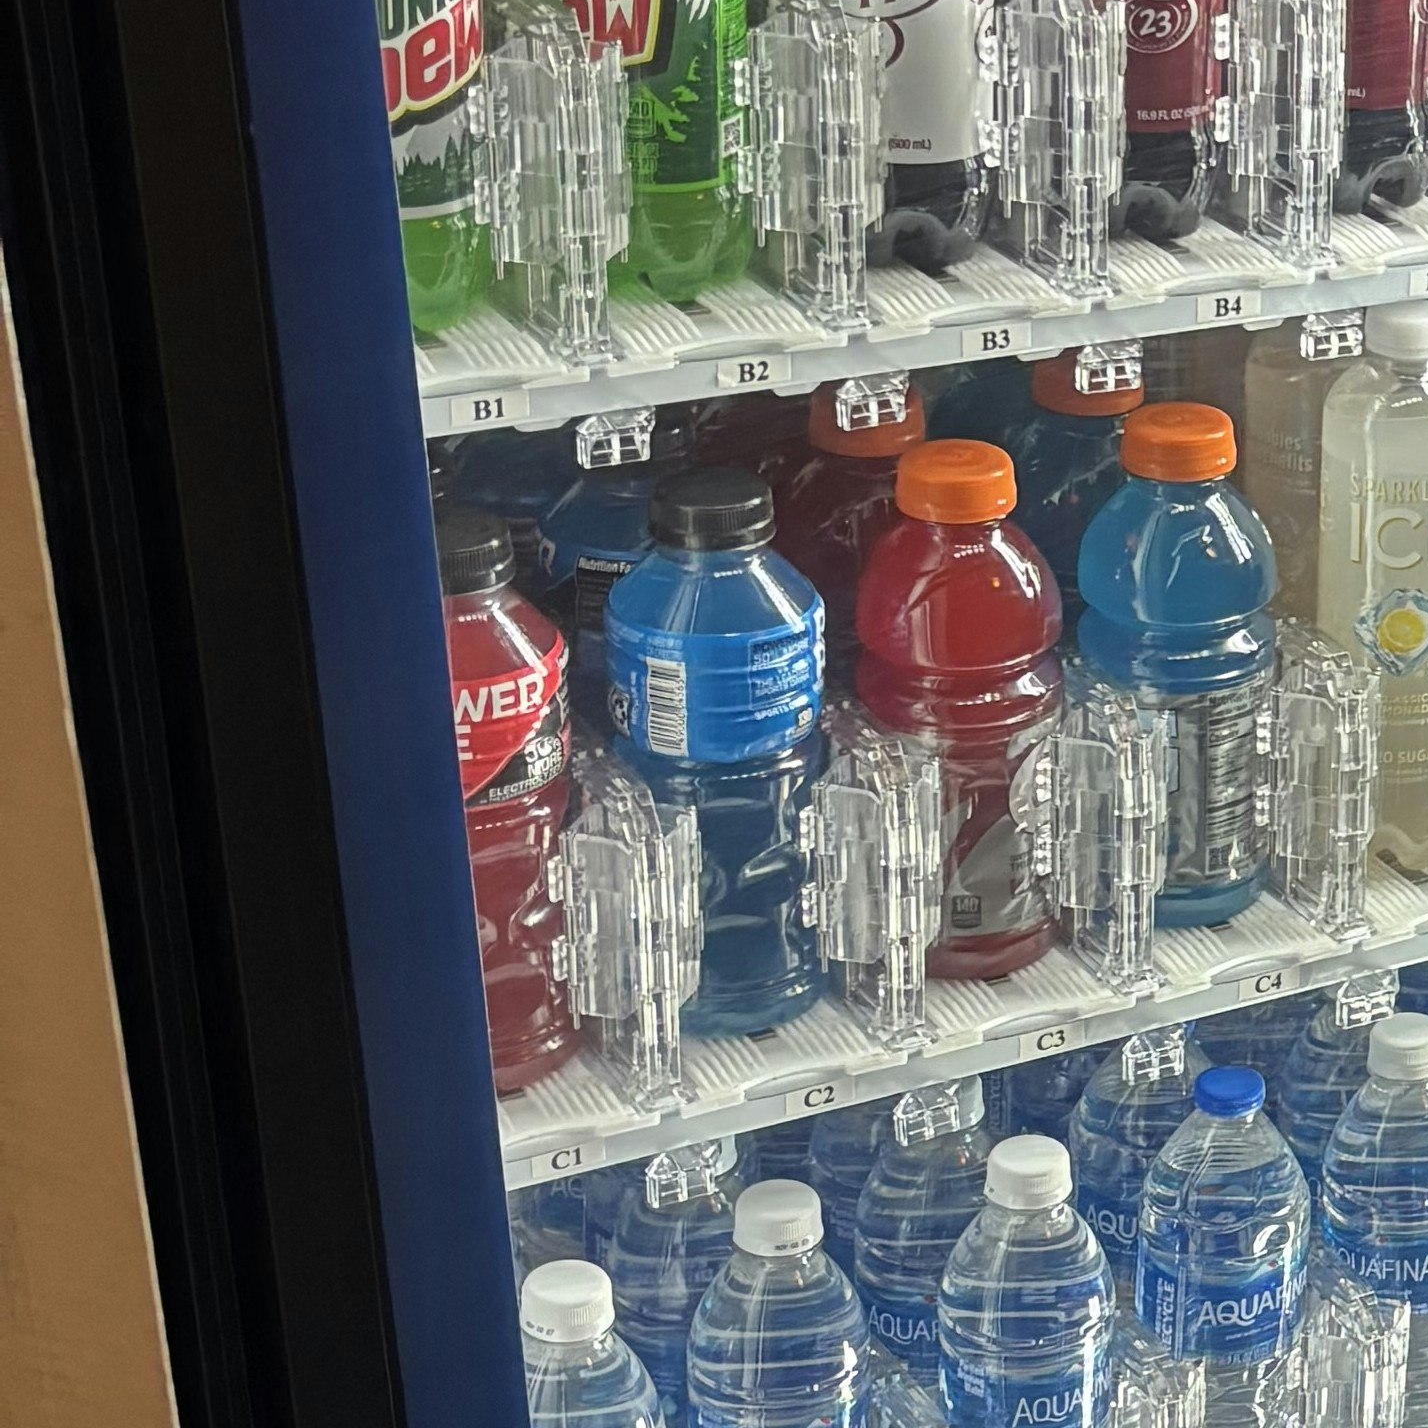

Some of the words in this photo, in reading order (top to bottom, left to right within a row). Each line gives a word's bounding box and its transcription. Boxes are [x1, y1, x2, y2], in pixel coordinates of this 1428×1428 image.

[1139, 9, 1171, 37] 23
[1136, 110, 1158, 121] 16.9
[1214, 294, 1243, 317] B4
[980, 327, 1011, 350] B3
[738, 358, 770, 383] B2
[474, 396, 505, 420] B1
[1255, 973, 1282, 993] C4
[1036, 1029, 1066, 1051] C3
[804, 1086, 835, 1109] C2
[551, 1146, 583, 1169] C1
